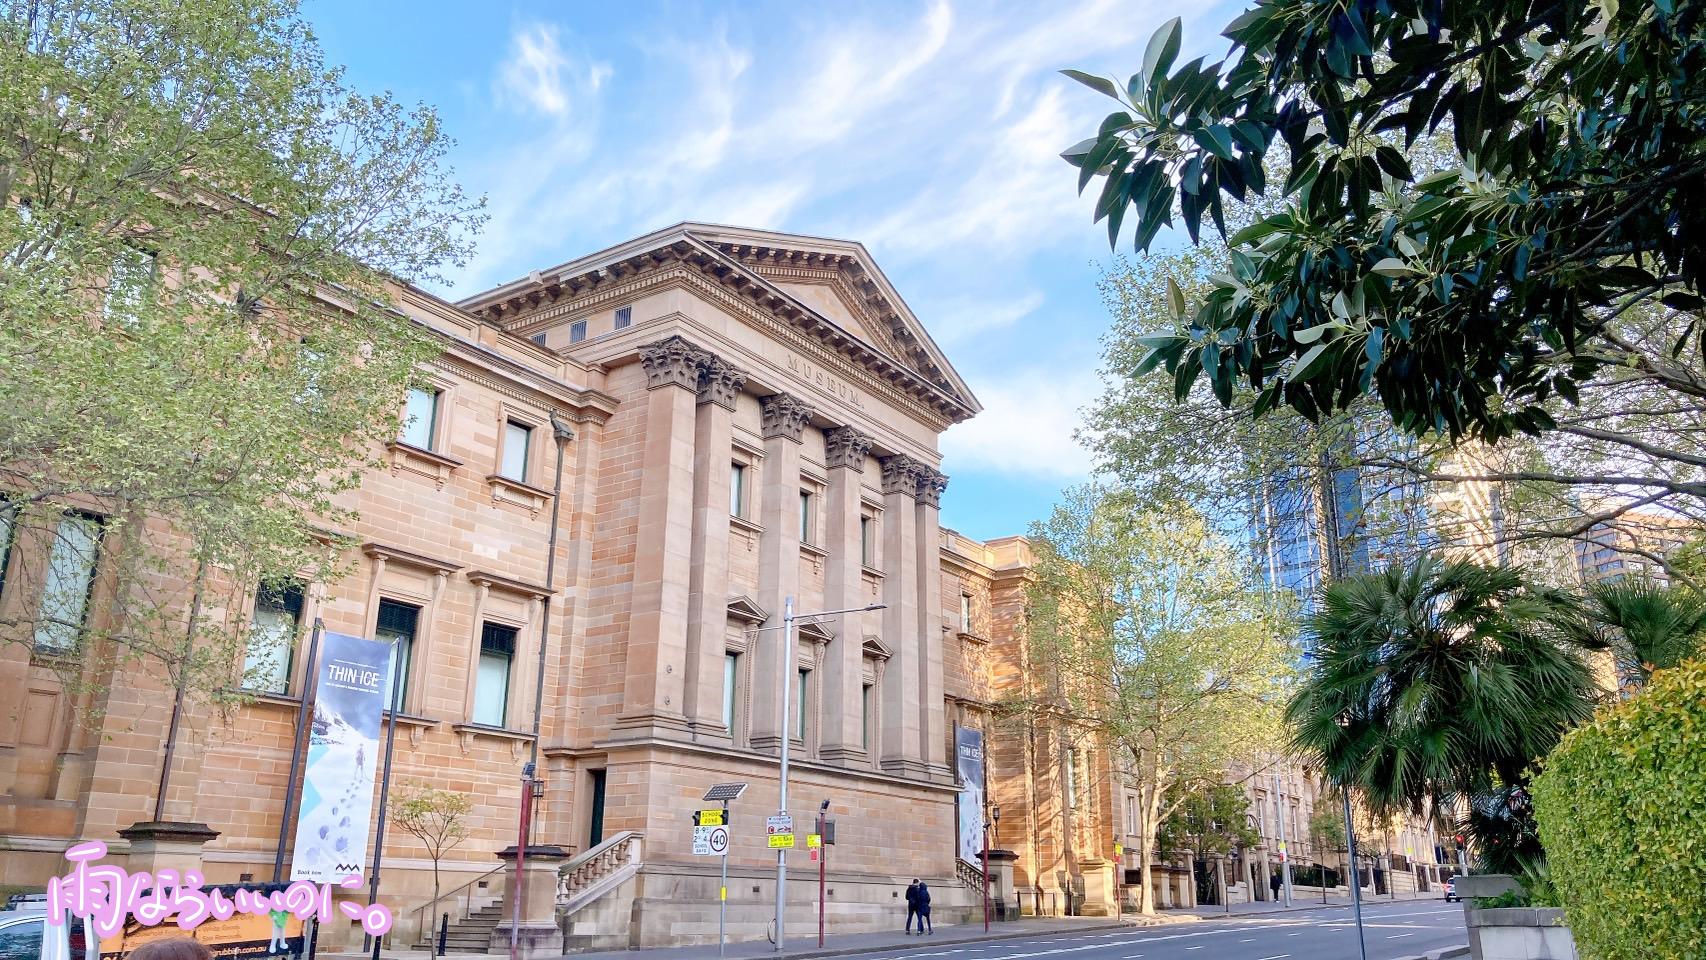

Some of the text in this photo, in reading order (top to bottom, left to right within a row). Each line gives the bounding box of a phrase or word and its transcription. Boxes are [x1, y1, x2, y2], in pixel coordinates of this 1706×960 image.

[328, 664, 380, 687] THIN ICE
[960, 745, 971, 757] THIN
[713, 834, 726, 846] 40
